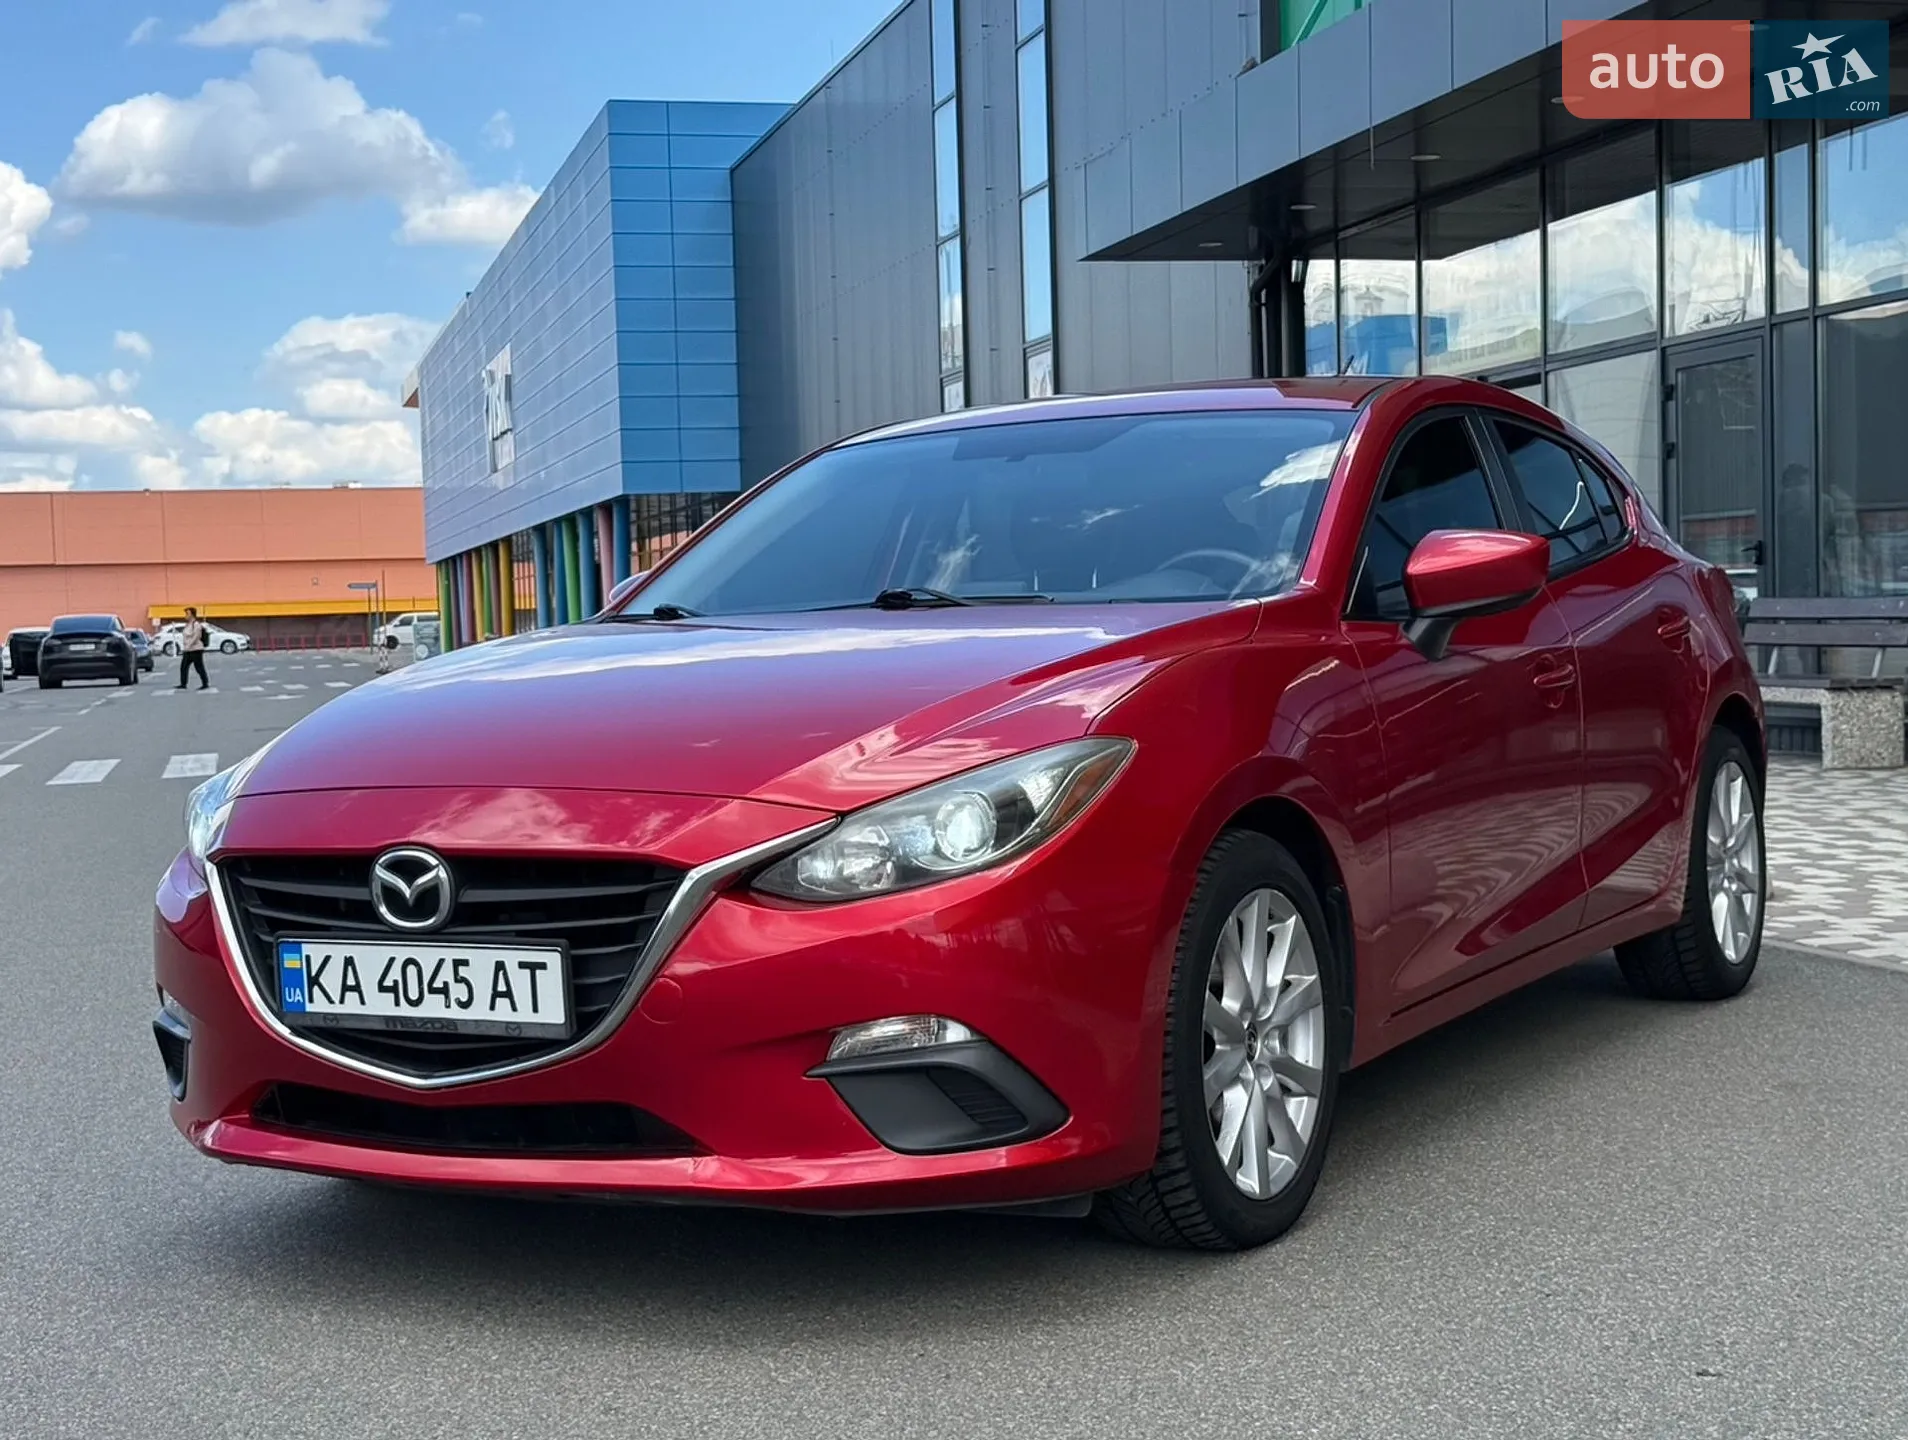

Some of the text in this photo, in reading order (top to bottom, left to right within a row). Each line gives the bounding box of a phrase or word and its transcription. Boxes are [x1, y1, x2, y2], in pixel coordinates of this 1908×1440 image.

[284, 987, 304, 1003] UA
[304, 954, 548, 1014] KA 4045 AT
